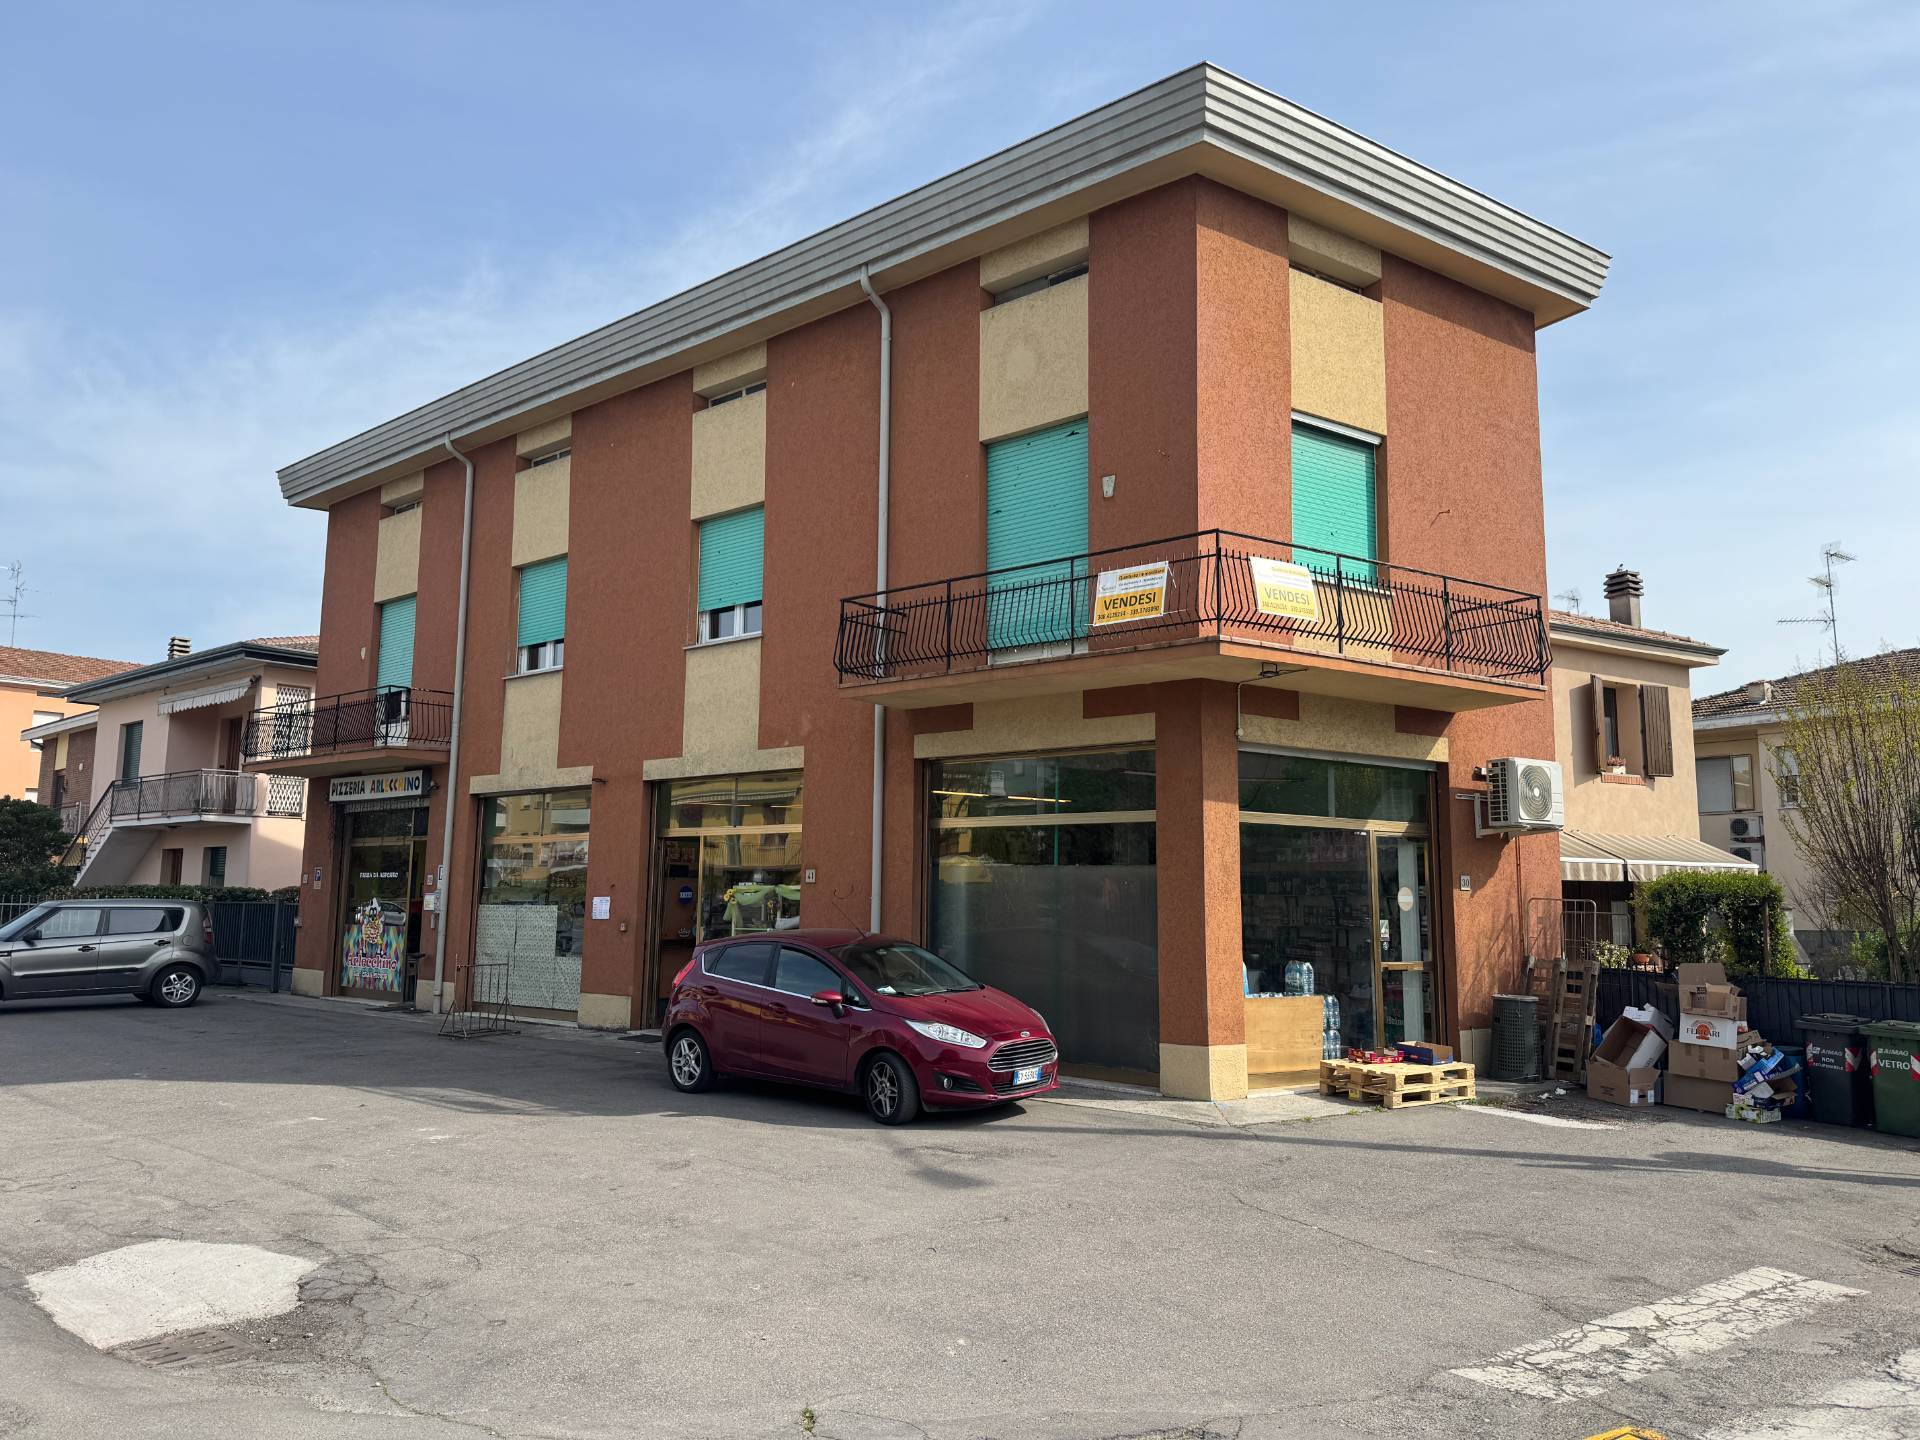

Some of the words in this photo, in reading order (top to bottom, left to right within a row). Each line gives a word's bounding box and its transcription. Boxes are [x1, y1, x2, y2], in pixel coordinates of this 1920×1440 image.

[1103, 591, 1157, 611] VENDESI
[1264, 586, 1310, 606] VENDESI
[331, 780, 365, 796] PIZZERIA
[370, 775, 421, 794] ARLECCHINO
[1461, 878, 1470, 888] 30
[1883, 1048, 1909, 1057] AIMAG
[1879, 1058, 1912, 1071] VETRO
